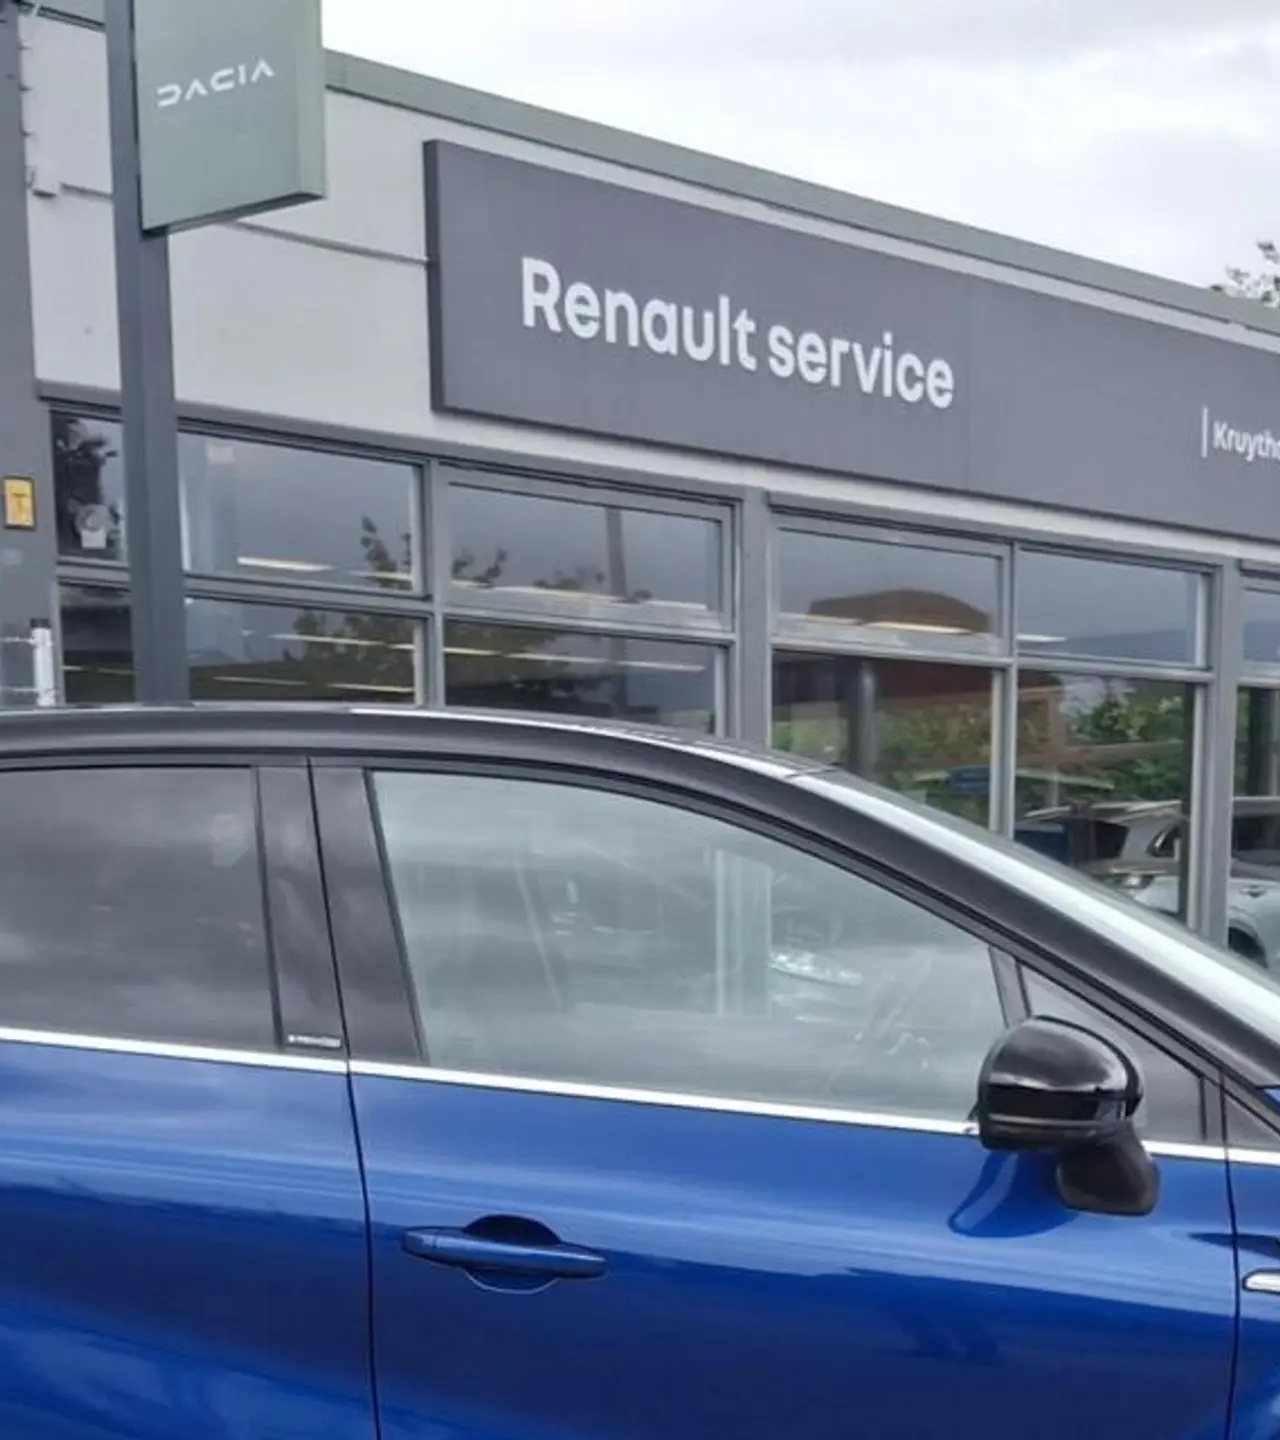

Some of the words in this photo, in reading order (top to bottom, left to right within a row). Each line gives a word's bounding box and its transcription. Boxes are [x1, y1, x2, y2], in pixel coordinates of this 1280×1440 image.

[158, 58, 275, 108] DACIA
[521, 256, 758, 372] Renault
[767, 324, 955, 408] service
